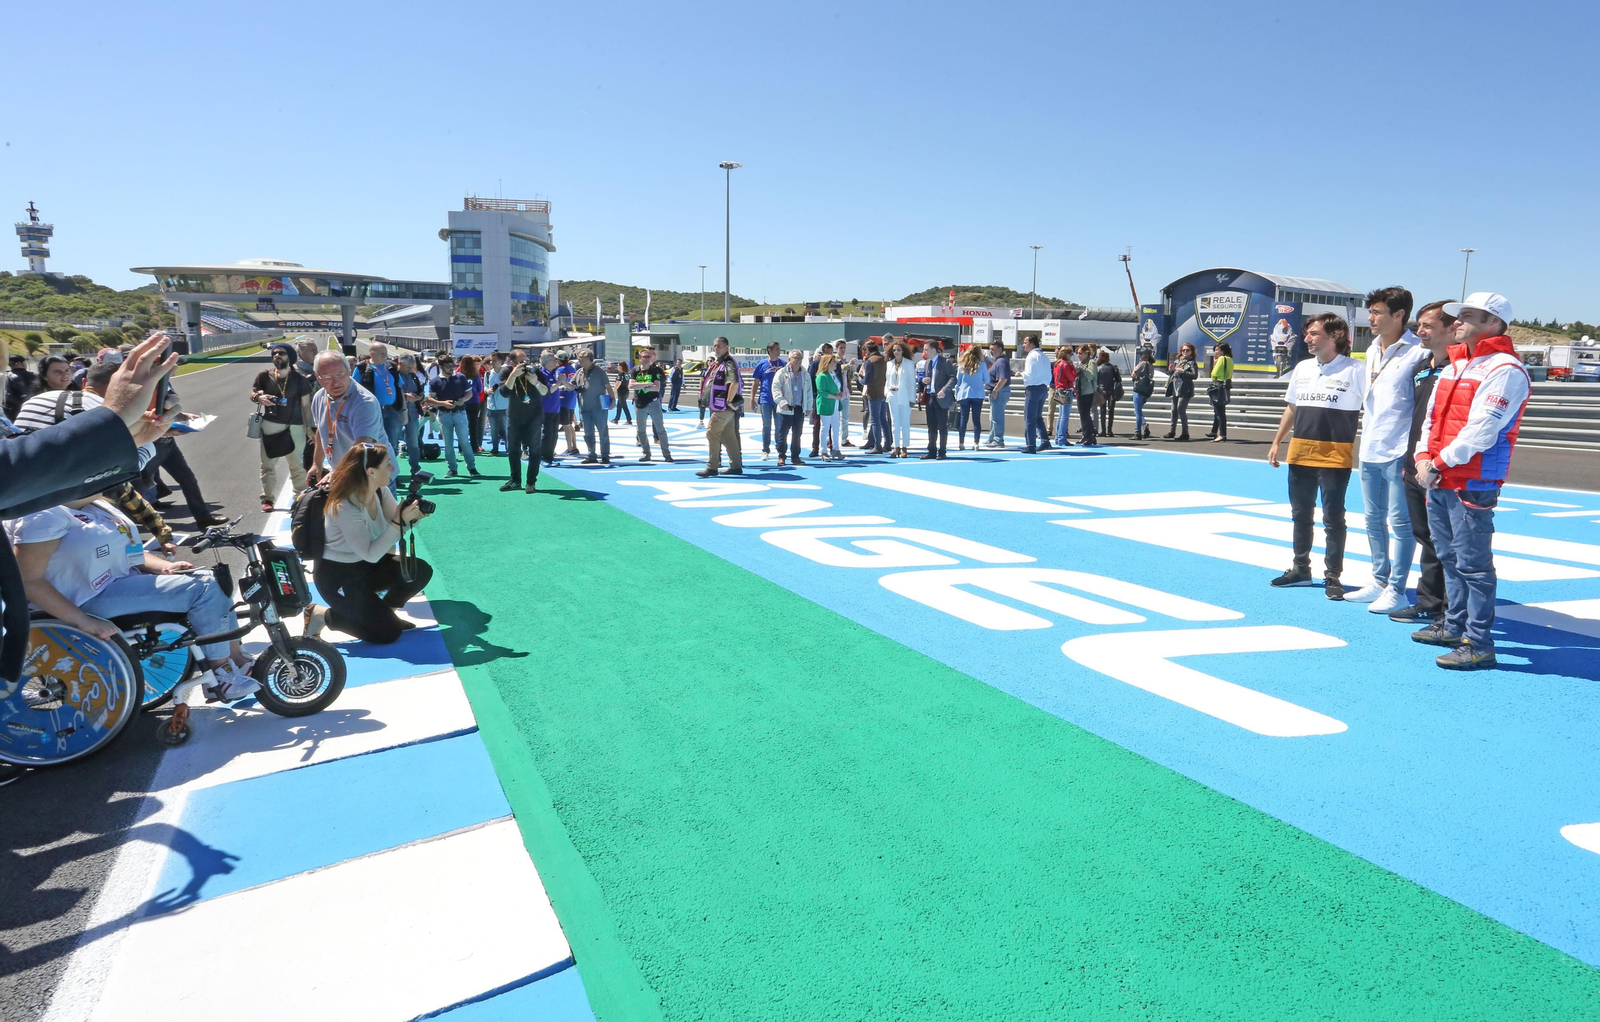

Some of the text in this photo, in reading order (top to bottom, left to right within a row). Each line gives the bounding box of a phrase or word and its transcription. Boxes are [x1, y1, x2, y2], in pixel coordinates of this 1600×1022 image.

[1212, 296, 1243, 304] REALE
[1204, 314, 1236, 325] Avintia
[1486, 395, 1509, 408] FIAMM
[273, 560, 294, 595] Triride
